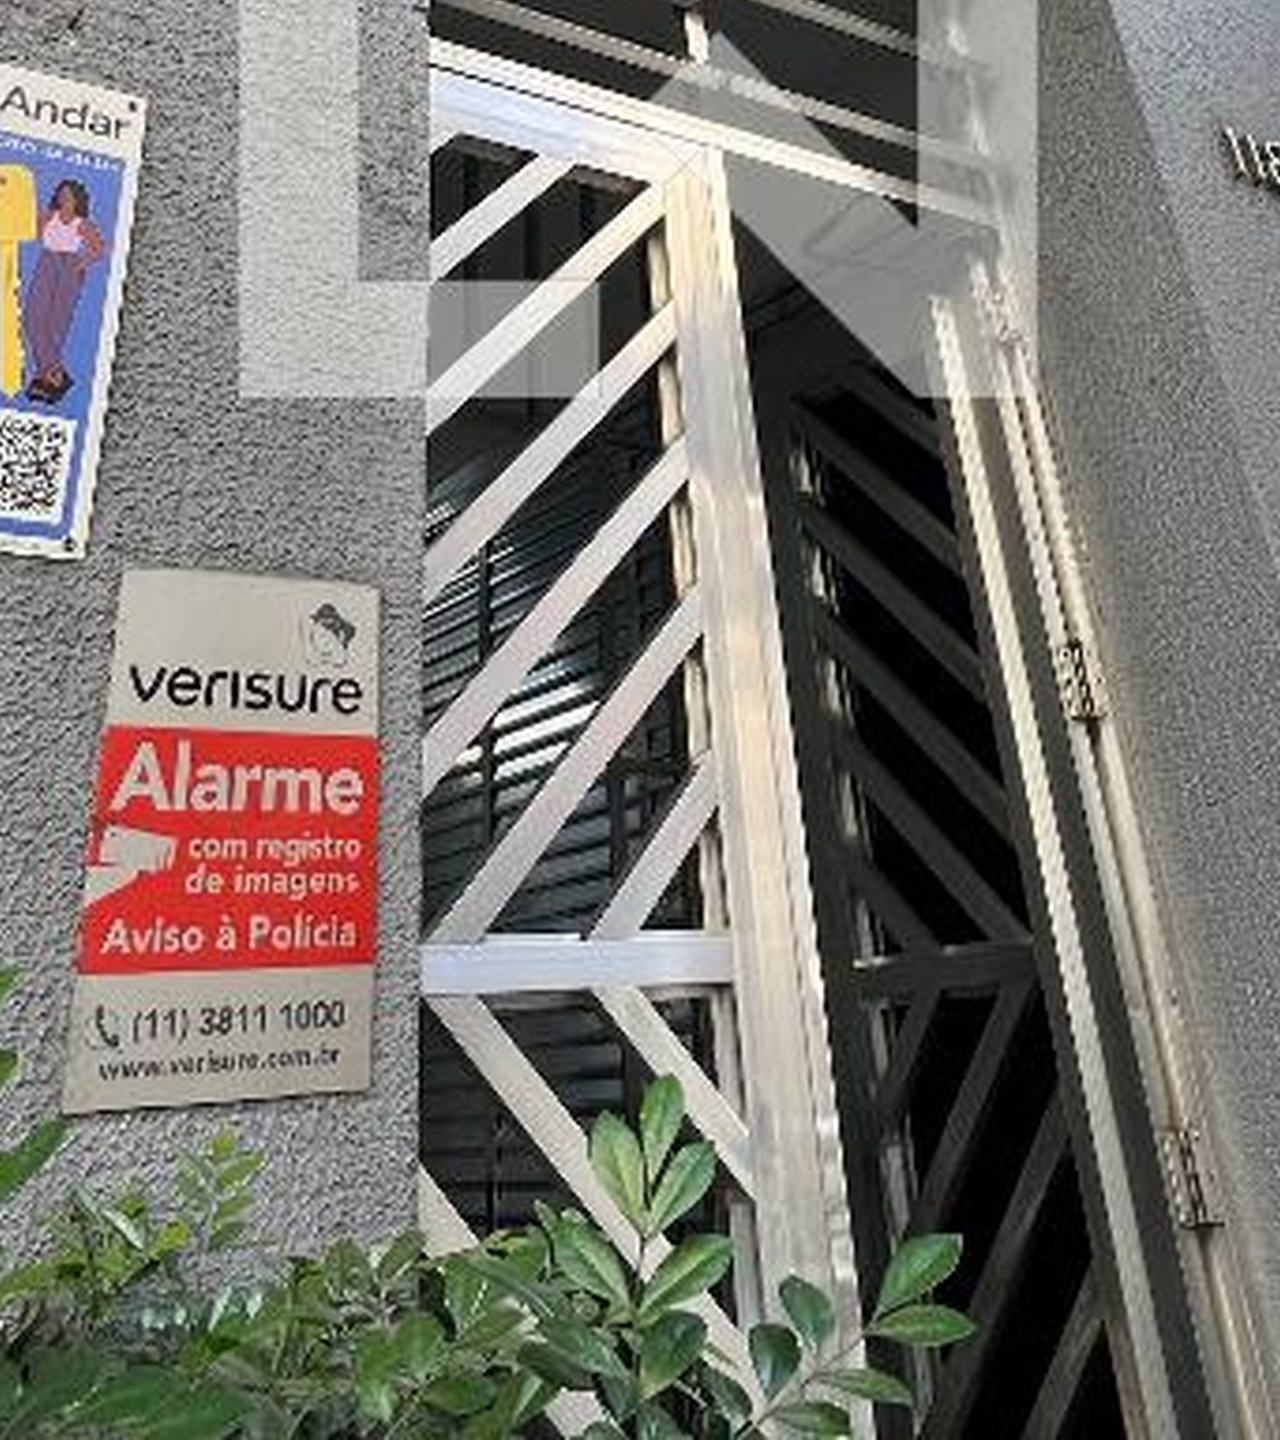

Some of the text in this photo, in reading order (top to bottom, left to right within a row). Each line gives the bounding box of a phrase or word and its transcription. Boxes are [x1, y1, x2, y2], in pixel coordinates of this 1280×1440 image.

[128, 663, 364, 714] verisure
[112, 741, 365, 816] Alarme
[188, 831, 362, 868] com registro
[185, 862, 360, 901] de imagens
[101, 914, 357, 954] Aviso à Polícia
[132, 1000, 346, 1044] (11) 3811 1000
[99, 1045, 341, 1080] www.verisure.com.br
